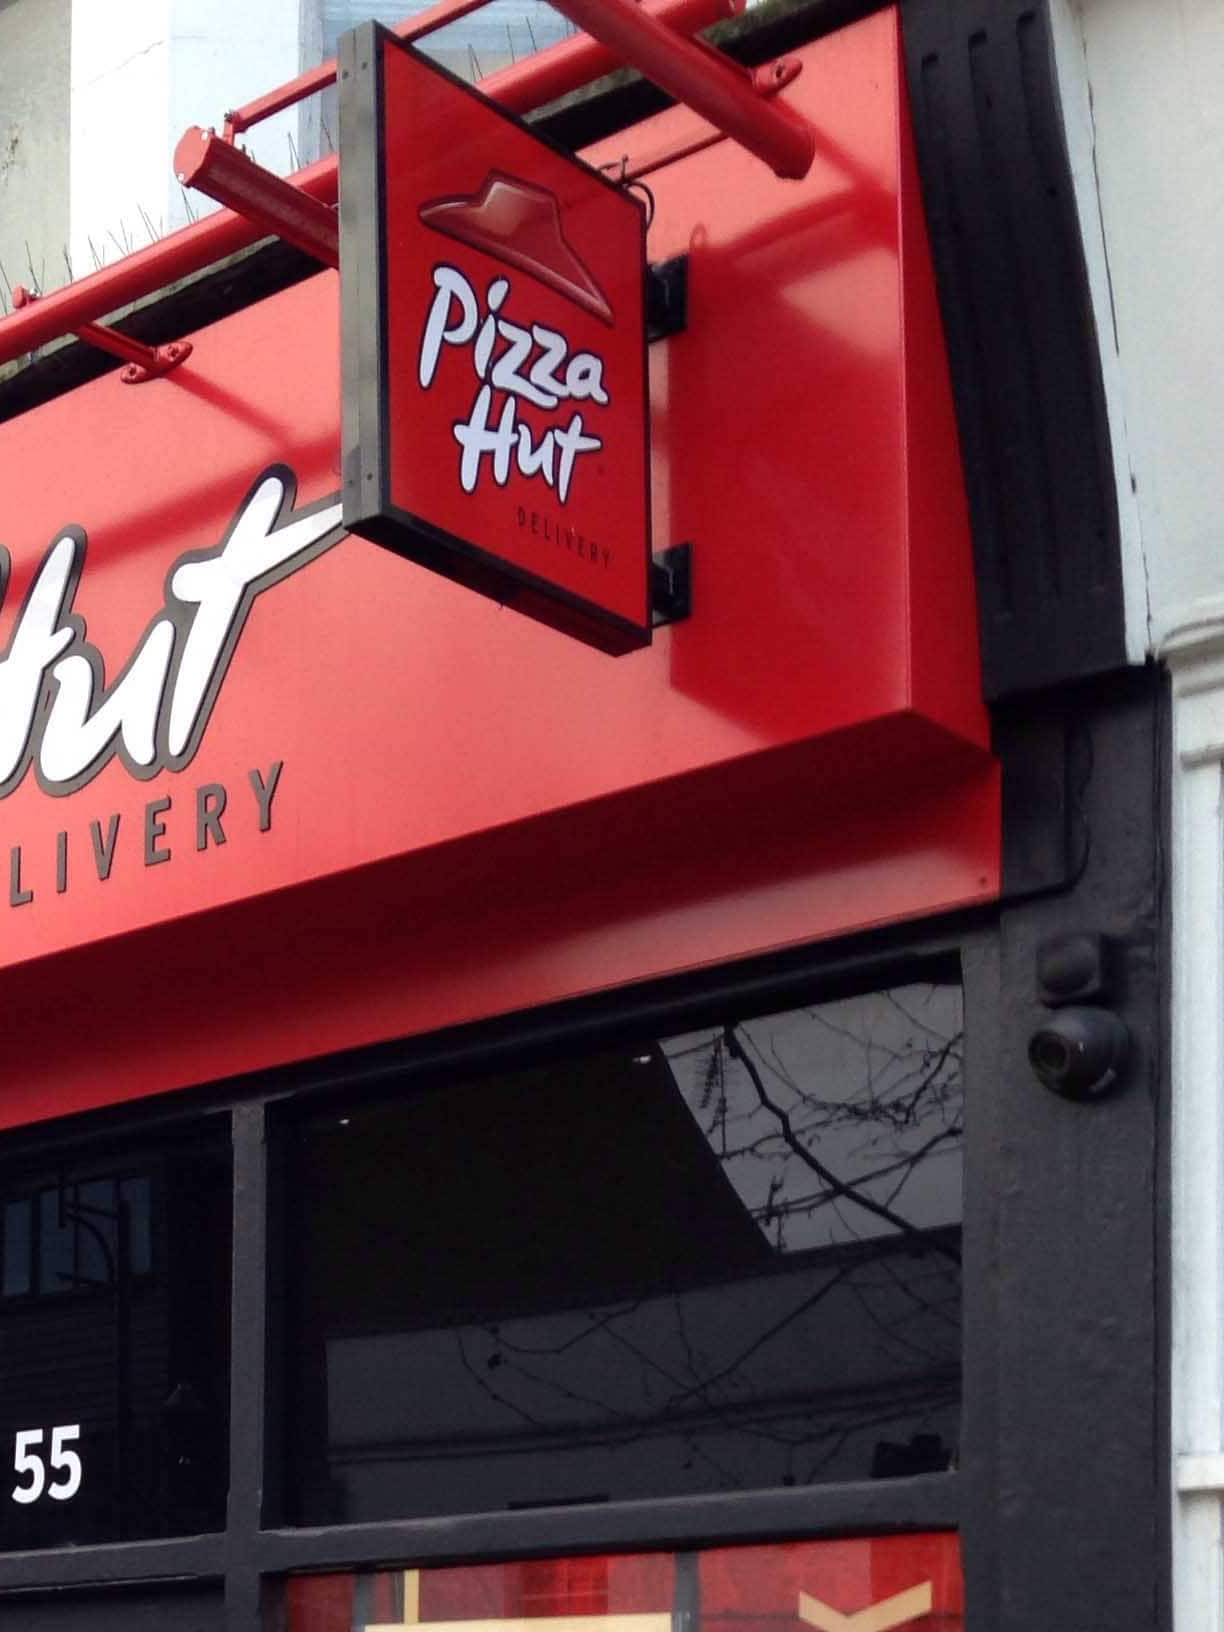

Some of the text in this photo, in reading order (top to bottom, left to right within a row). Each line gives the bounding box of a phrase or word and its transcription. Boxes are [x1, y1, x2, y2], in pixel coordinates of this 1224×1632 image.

[419, 265, 609, 409] Pizza
[453, 384, 602, 504] Hut
[517, 507, 611, 568] DELIVERY
[11, 1424, 82, 1504] 55
